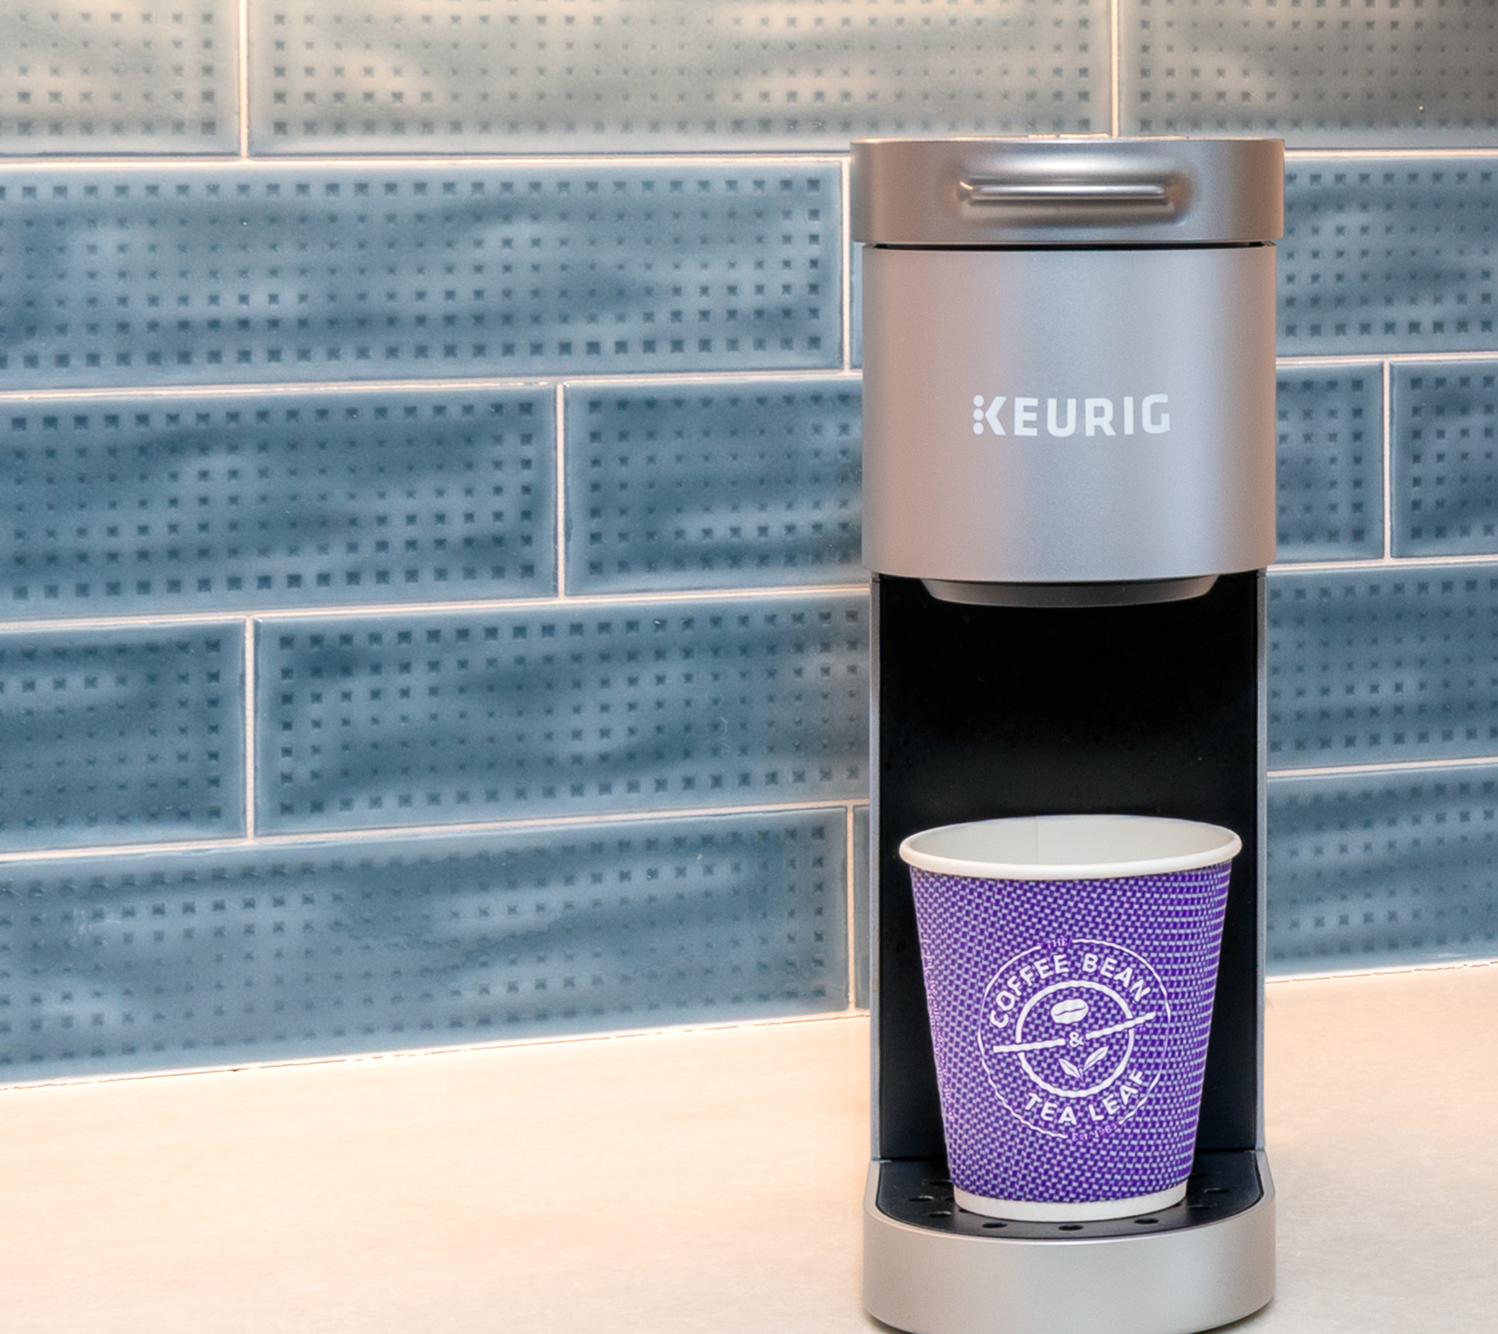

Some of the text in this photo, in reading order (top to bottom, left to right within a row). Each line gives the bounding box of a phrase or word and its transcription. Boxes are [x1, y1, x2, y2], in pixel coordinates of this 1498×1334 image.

[972, 393, 1171, 438] KEURIG
[989, 952, 1151, 1029] COFFEE BEAN
[1068, 1031, 1084, 1048] &
[1024, 1068, 1143, 1126] TEA LEAF
